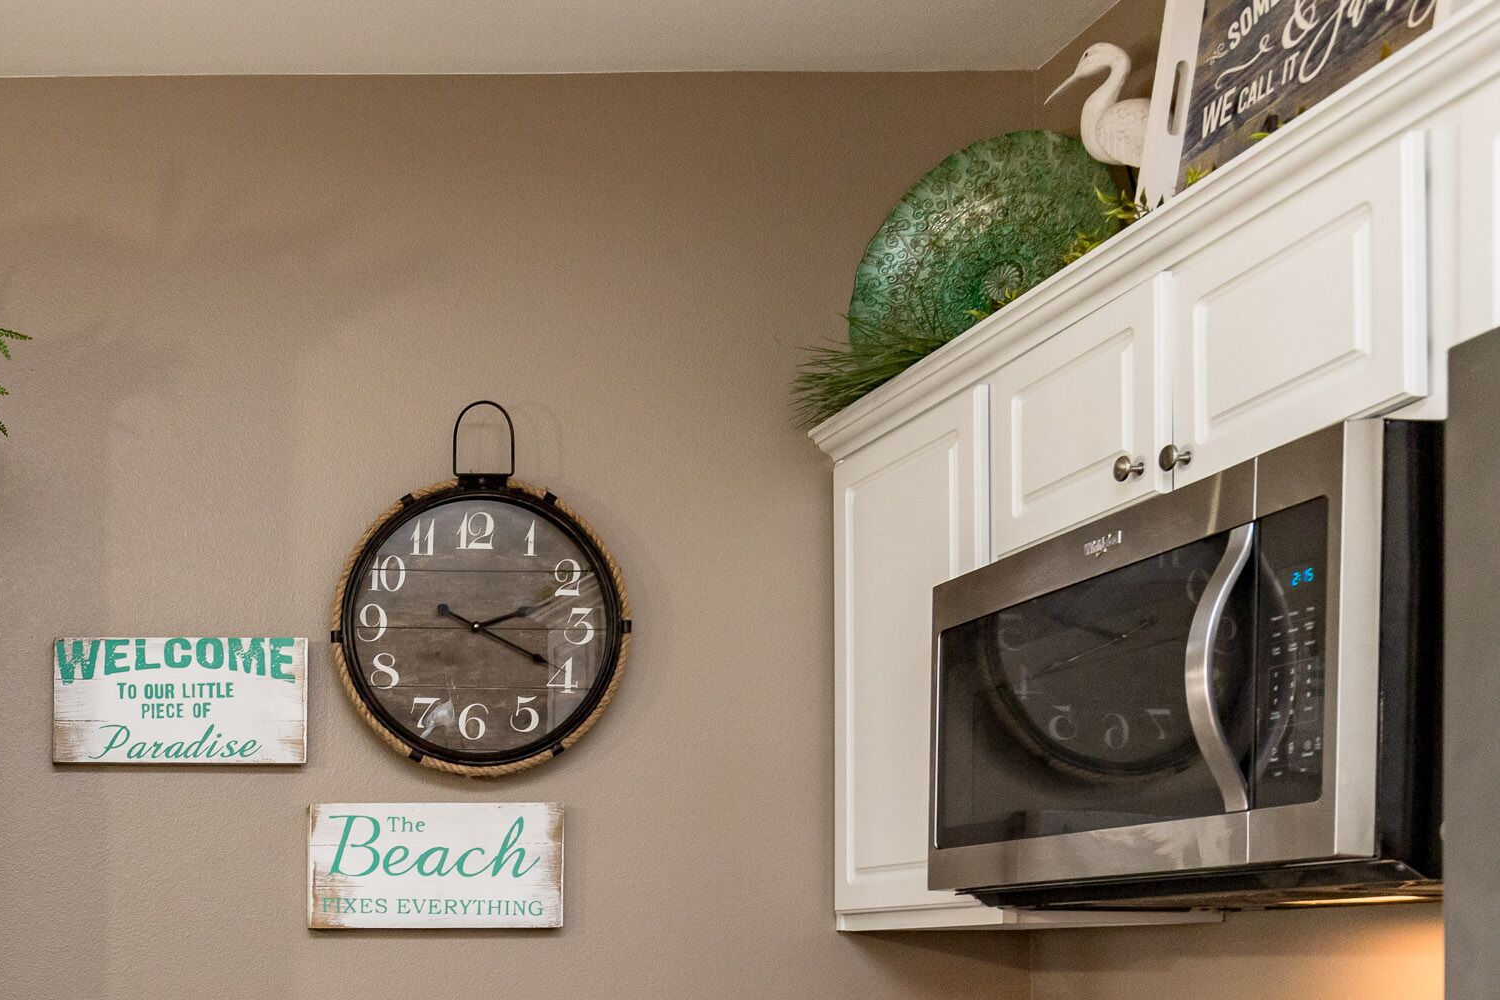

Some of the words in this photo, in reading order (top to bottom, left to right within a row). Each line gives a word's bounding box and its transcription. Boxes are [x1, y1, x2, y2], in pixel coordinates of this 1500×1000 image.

[1201, 86, 1233, 139] WE
[1237, 73, 1275, 115] CALL
[1281, 50, 1301, 86] IT
[410, 518, 435, 556] 11
[455, 511, 494, 550] 12
[523, 519, 538, 557] 1
[367, 555, 406, 592] 10
[554, 558, 581, 596] 2
[357, 603, 388, 642] 9
[563, 607, 594, 645] 3
[56, 637, 296, 685] WELCOME
[370, 652, 399, 689] 8
[546, 656, 578, 694] 4
[116, 682, 137, 699] TO
[143, 682, 175, 699] OUR
[182, 682, 234, 699] LITTLE
[141, 703, 184, 719] PIECE
[192, 702, 212, 718] OF
[410, 697, 440, 729] 7
[458, 703, 489, 740] 6
[509, 695, 539, 732] 5
[88, 724, 263, 760] Paradise
[387, 816, 426, 833] The
[328, 815, 541, 879] Beach
[322, 897, 388, 914] FIXES
[397, 898, 544, 916] EVERYTHING
